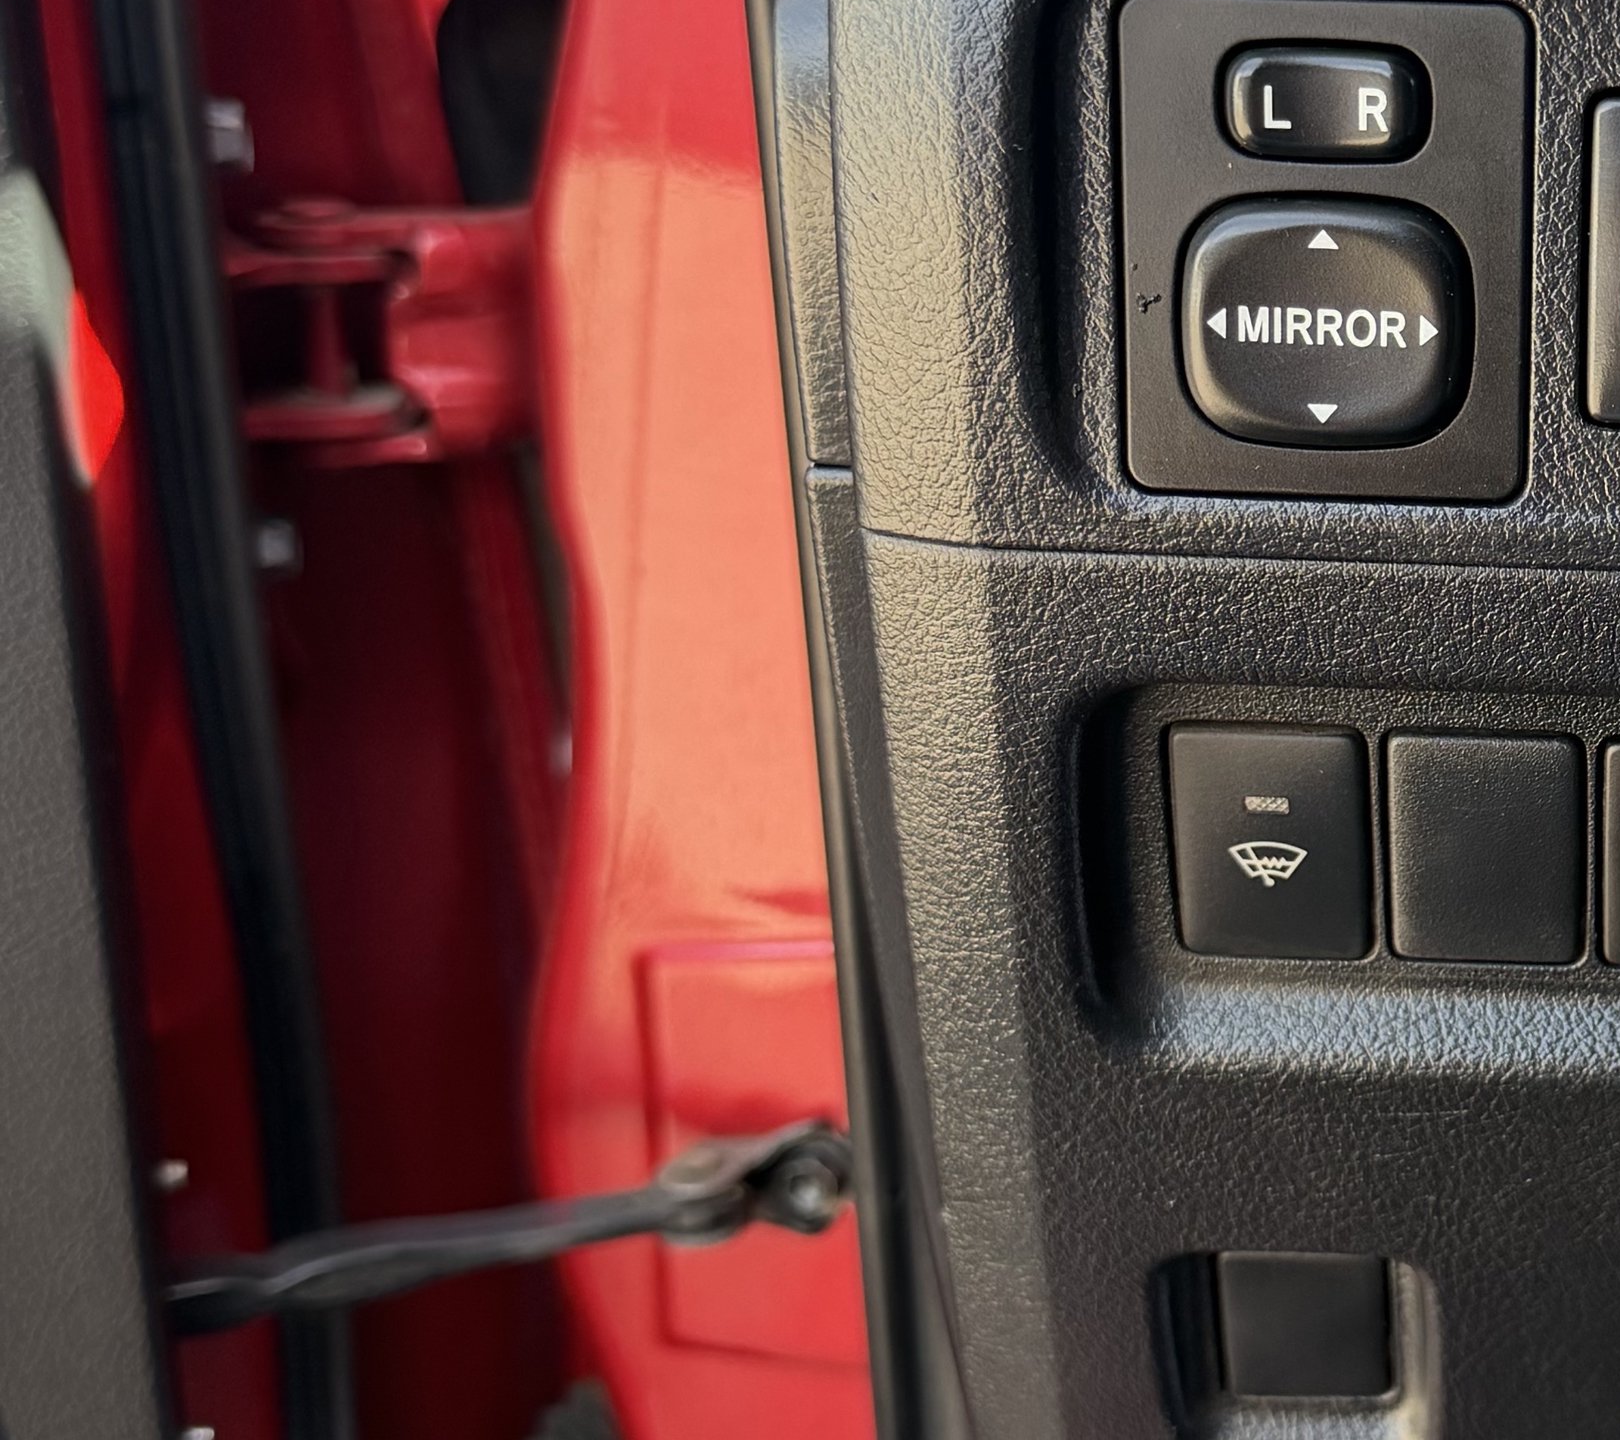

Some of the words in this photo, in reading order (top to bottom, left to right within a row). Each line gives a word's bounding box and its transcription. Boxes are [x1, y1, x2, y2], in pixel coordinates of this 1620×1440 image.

[1263, 84, 1292, 130] L
[1358, 85, 1388, 134] R
[1236, 303, 1408, 350] MIRROR
